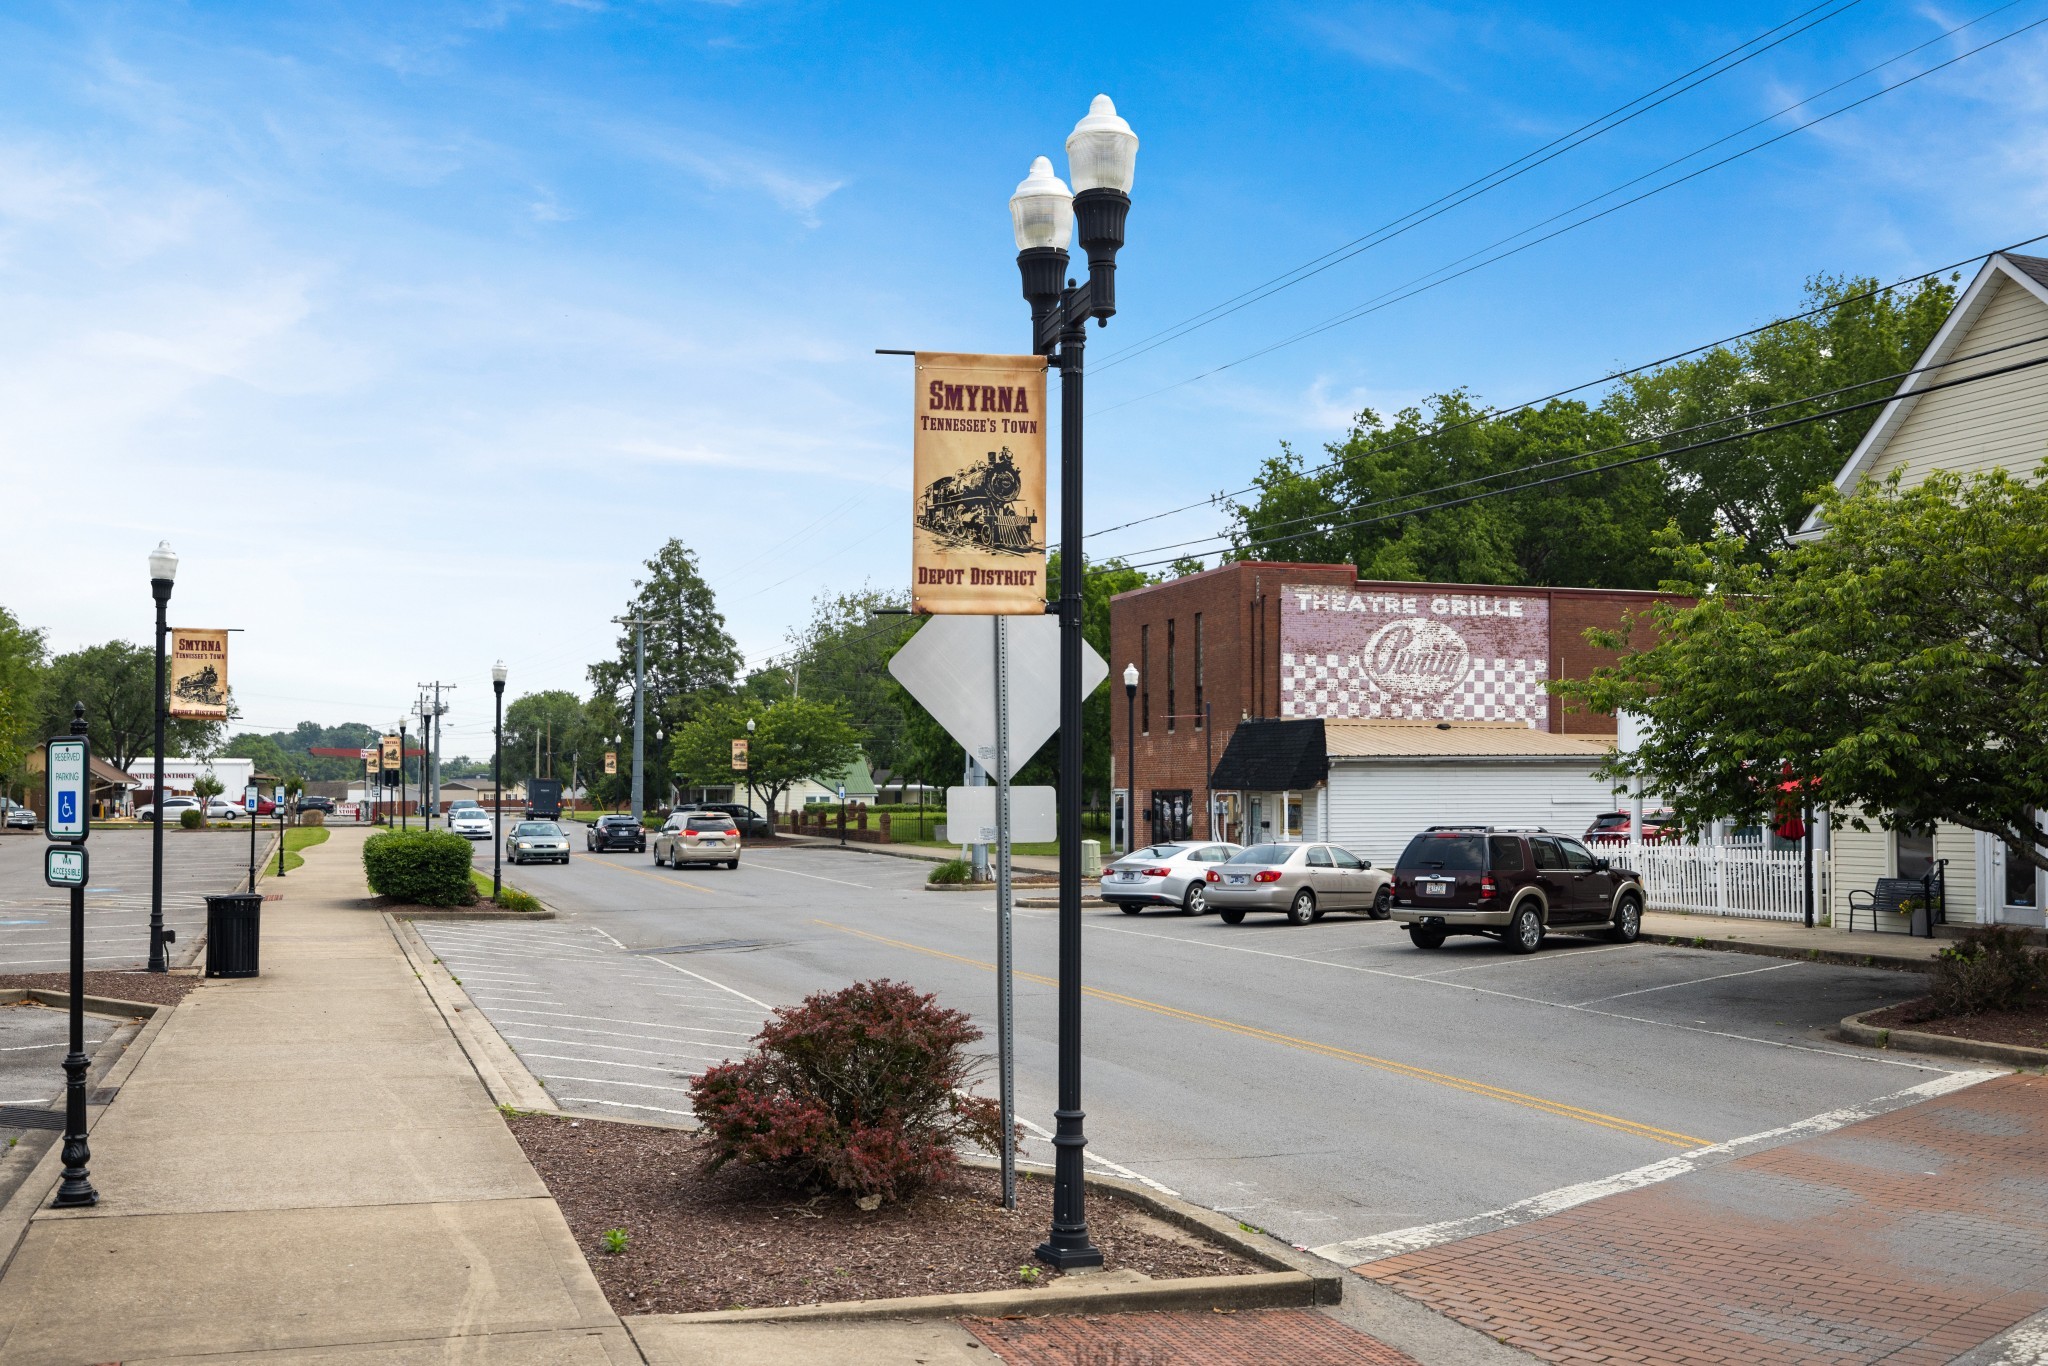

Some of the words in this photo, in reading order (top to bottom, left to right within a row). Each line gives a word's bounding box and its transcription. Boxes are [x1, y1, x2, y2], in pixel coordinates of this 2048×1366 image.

[929, 380, 1029, 413] SMYRNA
[921, 415, 997, 433] TENNESSEE'S
[1001, 418, 1037, 434] TOWN
[918, 567, 964, 585] DEPOT
[970, 567, 1037, 586] DISTRICT
[1294, 593, 1417, 614] THEATRE
[1430, 597, 1524, 617] GRILLE
[179, 638, 221, 652] SMYRNA
[210, 652, 225, 660] TOWN
[54, 752, 81, 762] RESERVED
[55, 772, 80, 781] PARKING
[62, 857, 72, 865] VAN
[53, 867, 81, 877] ACCESSIBLE
